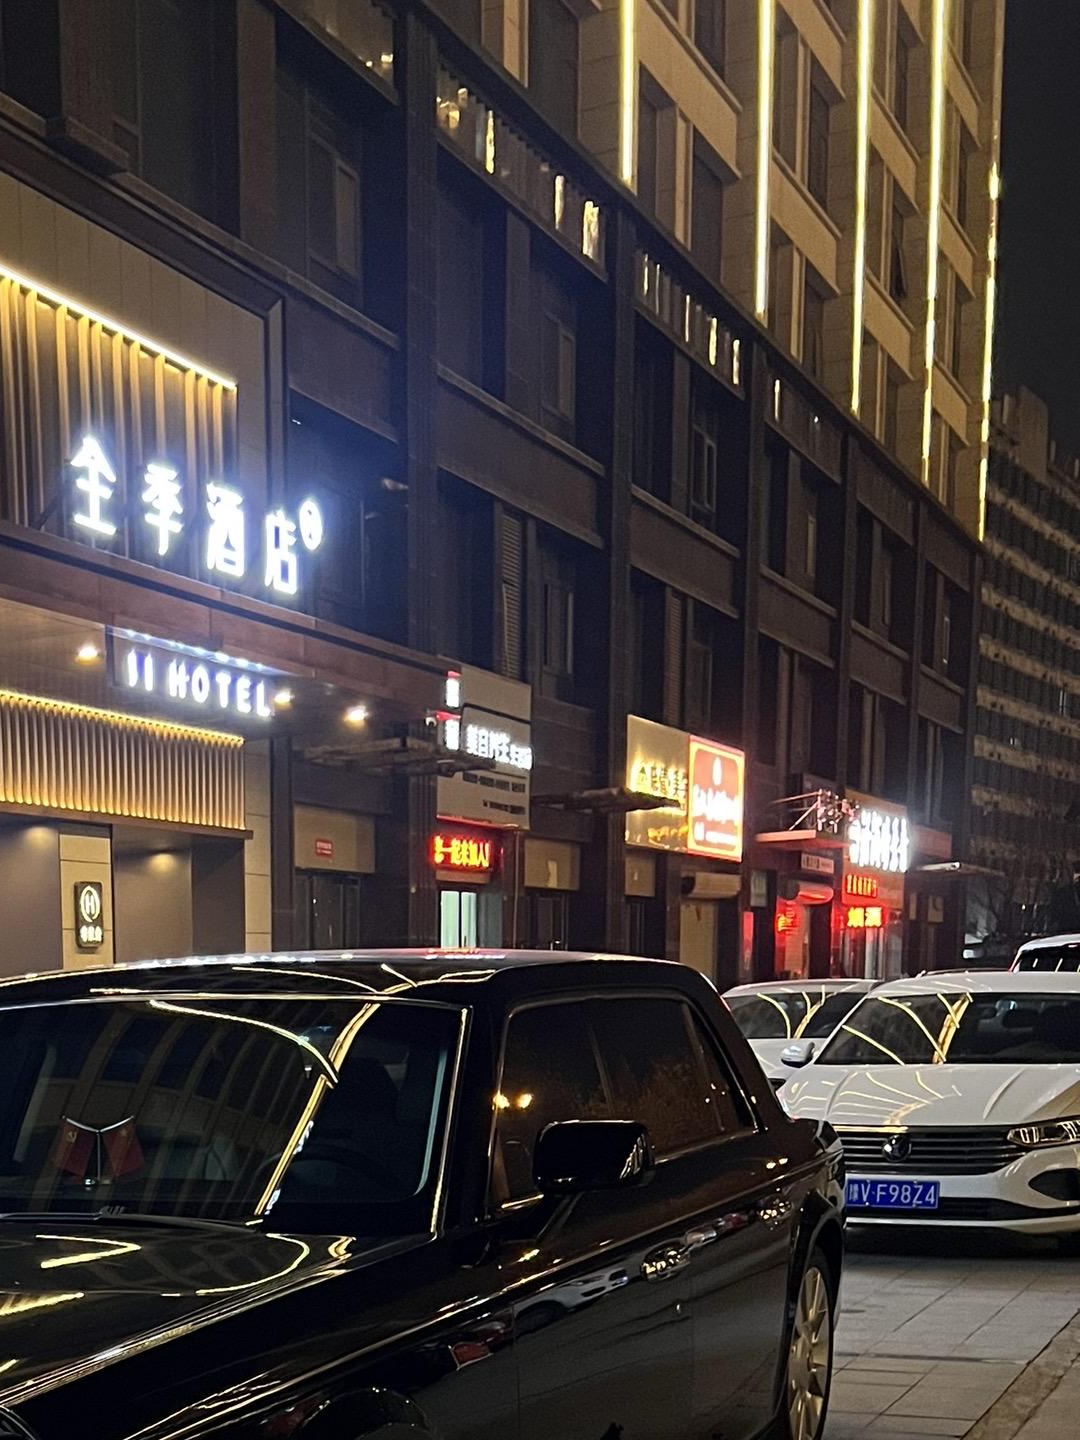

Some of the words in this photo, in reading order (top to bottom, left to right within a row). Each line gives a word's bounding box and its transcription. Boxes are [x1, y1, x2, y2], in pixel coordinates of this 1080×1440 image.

[70, 436, 298, 595] 全季酒店
[168, 659, 271, 718] HOTEL
